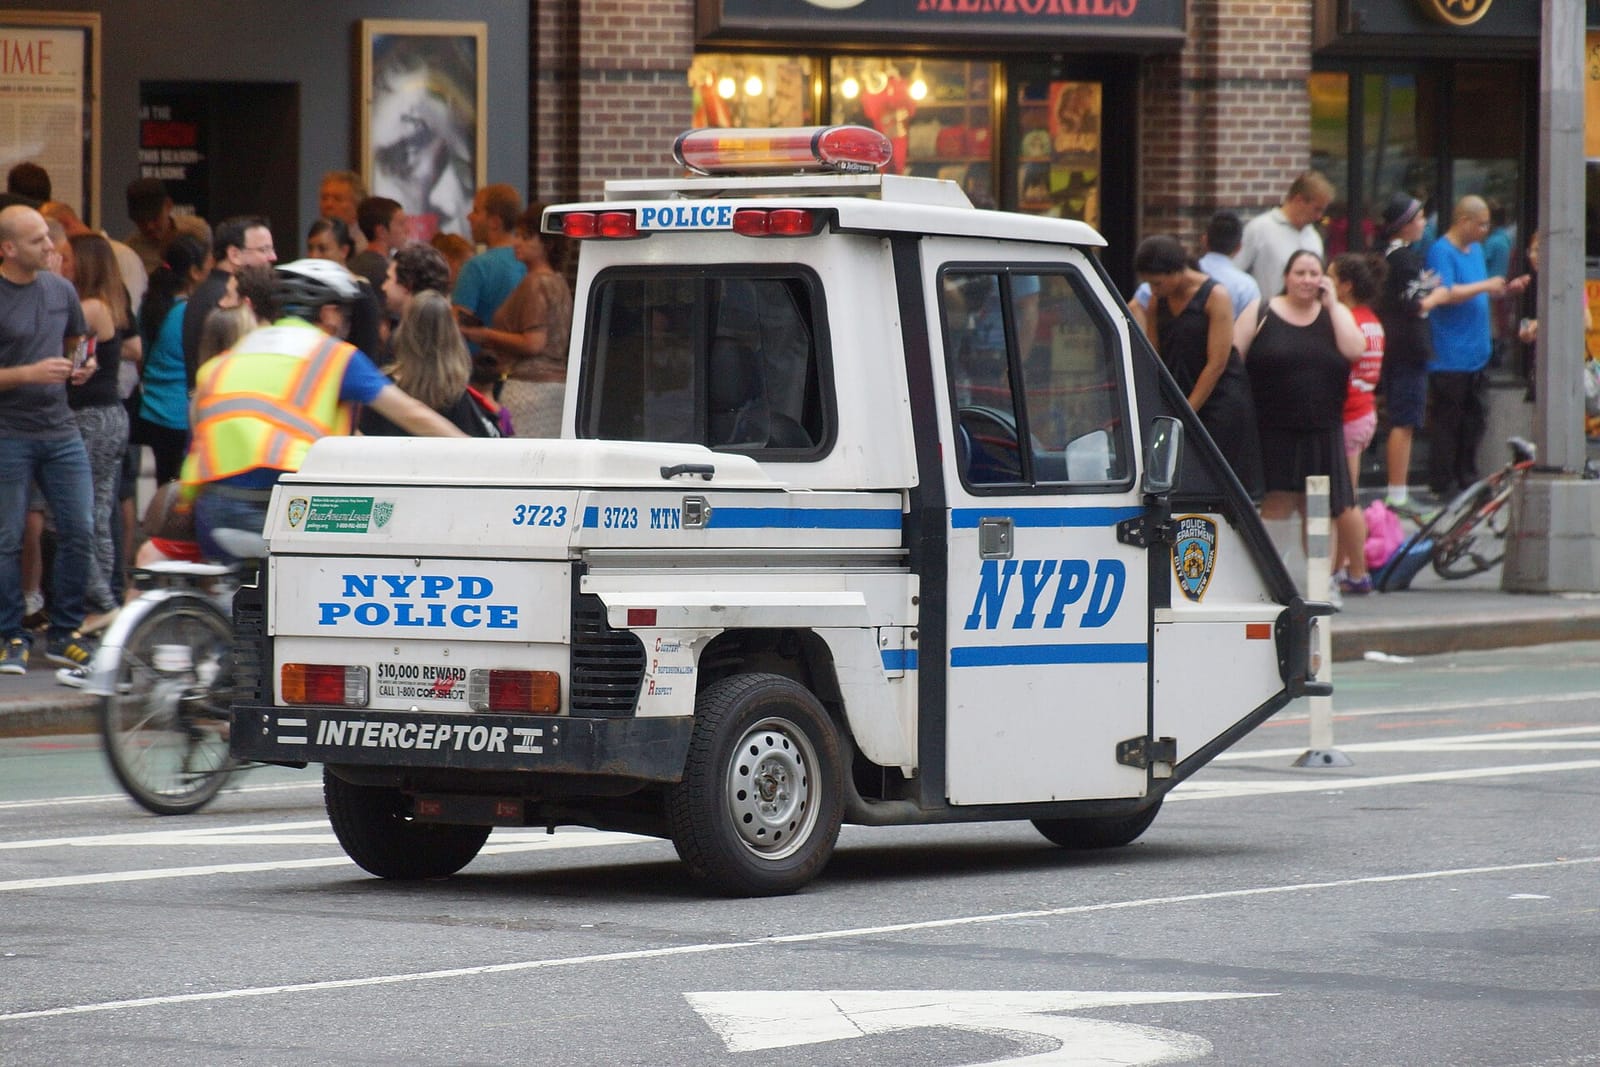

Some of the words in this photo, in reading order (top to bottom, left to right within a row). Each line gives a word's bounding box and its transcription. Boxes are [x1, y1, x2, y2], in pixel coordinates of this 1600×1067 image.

[0, 38, 53, 75] IME
[641, 205, 731, 227] POLICE
[512, 504, 567, 528] 3723
[604, 506, 638, 529] 3723
[650, 507, 681, 530] MTN
[1181, 519, 1206, 529] POLICE
[342, 574, 494, 599] NYPD
[963, 558, 1127, 630] NYPD
[318, 602, 519, 629] POLICE
[378, 663, 419, 680] $10,000
[423, 667, 466, 681] REWARD
[380, 686, 395, 696] CALL
[397, 687, 415, 697] 1-800
[316, 720, 508, 752] INTERCEPTOR
